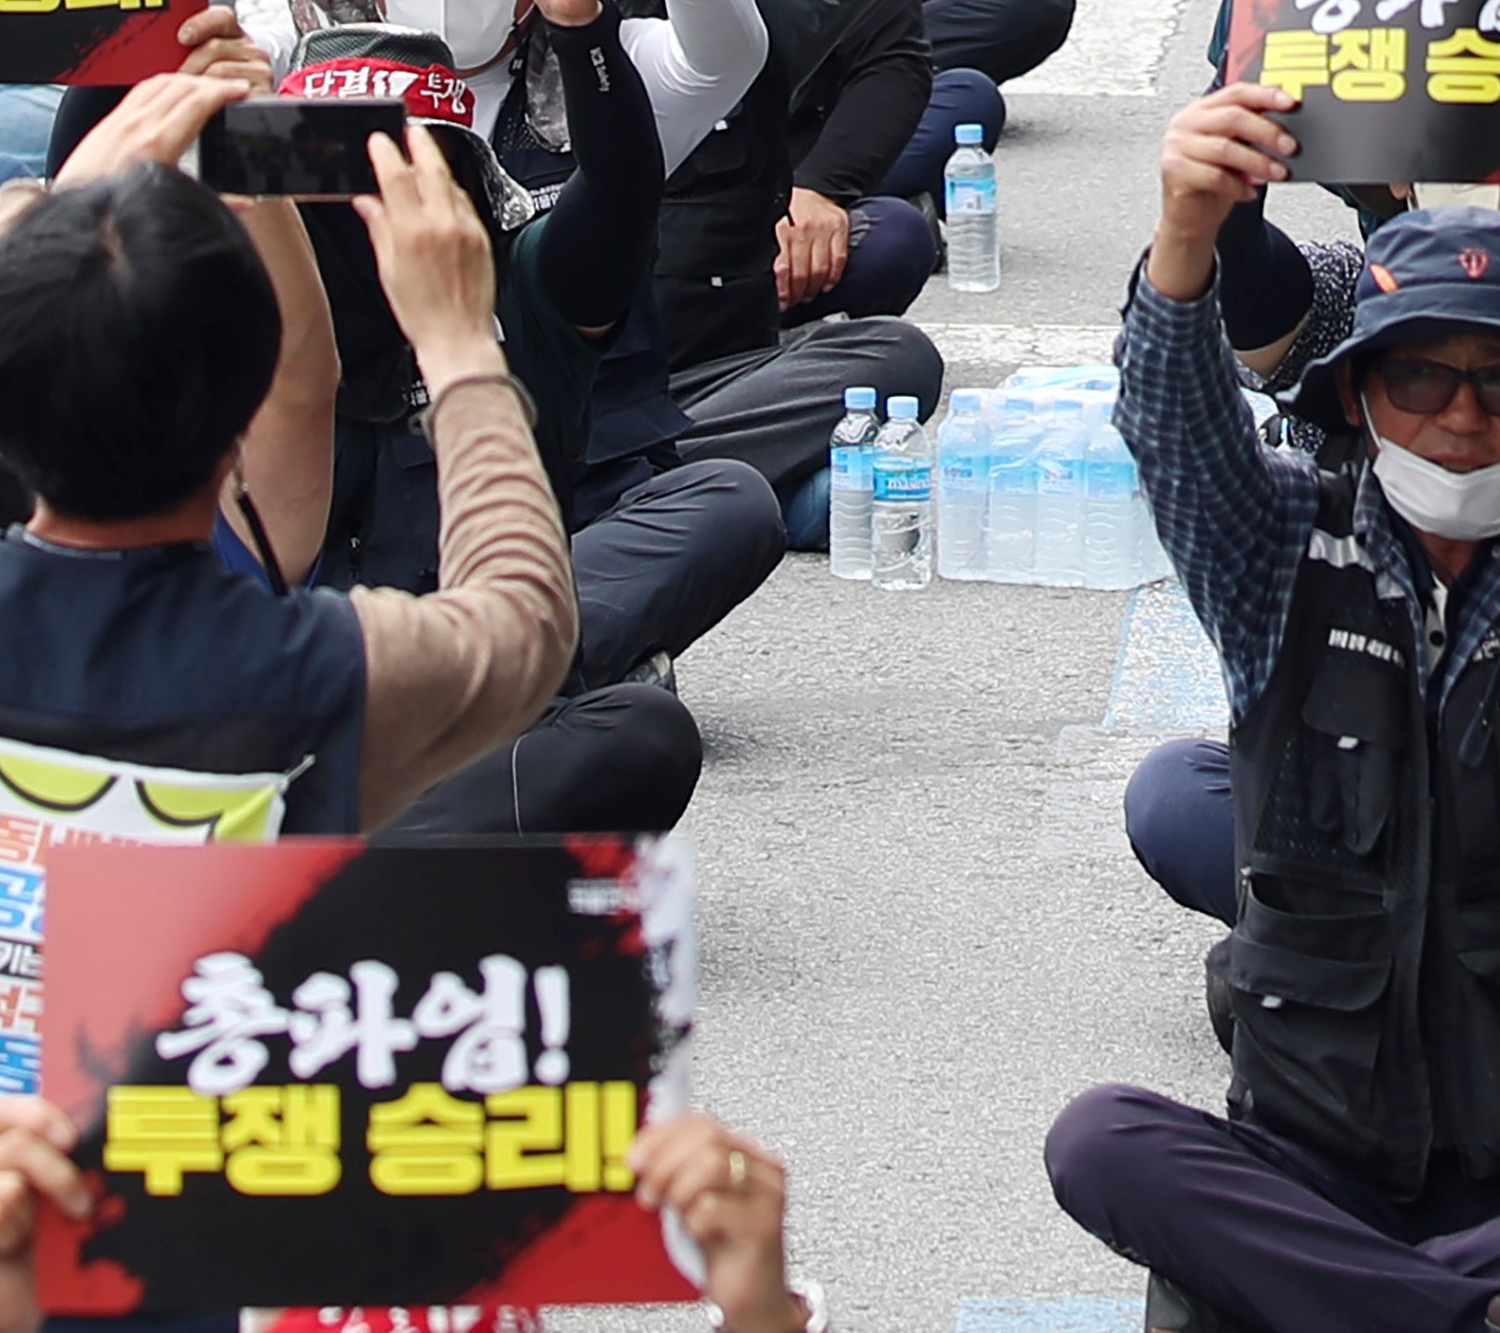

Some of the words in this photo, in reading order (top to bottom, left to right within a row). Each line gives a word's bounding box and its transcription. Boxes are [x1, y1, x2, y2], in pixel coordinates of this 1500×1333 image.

[1258, 27, 1407, 102] 투쟁
[157, 953, 567, 1096] 총파업!
[103, 1085, 341, 1194] 투쟁
[367, 1082, 636, 1193] 승리!
